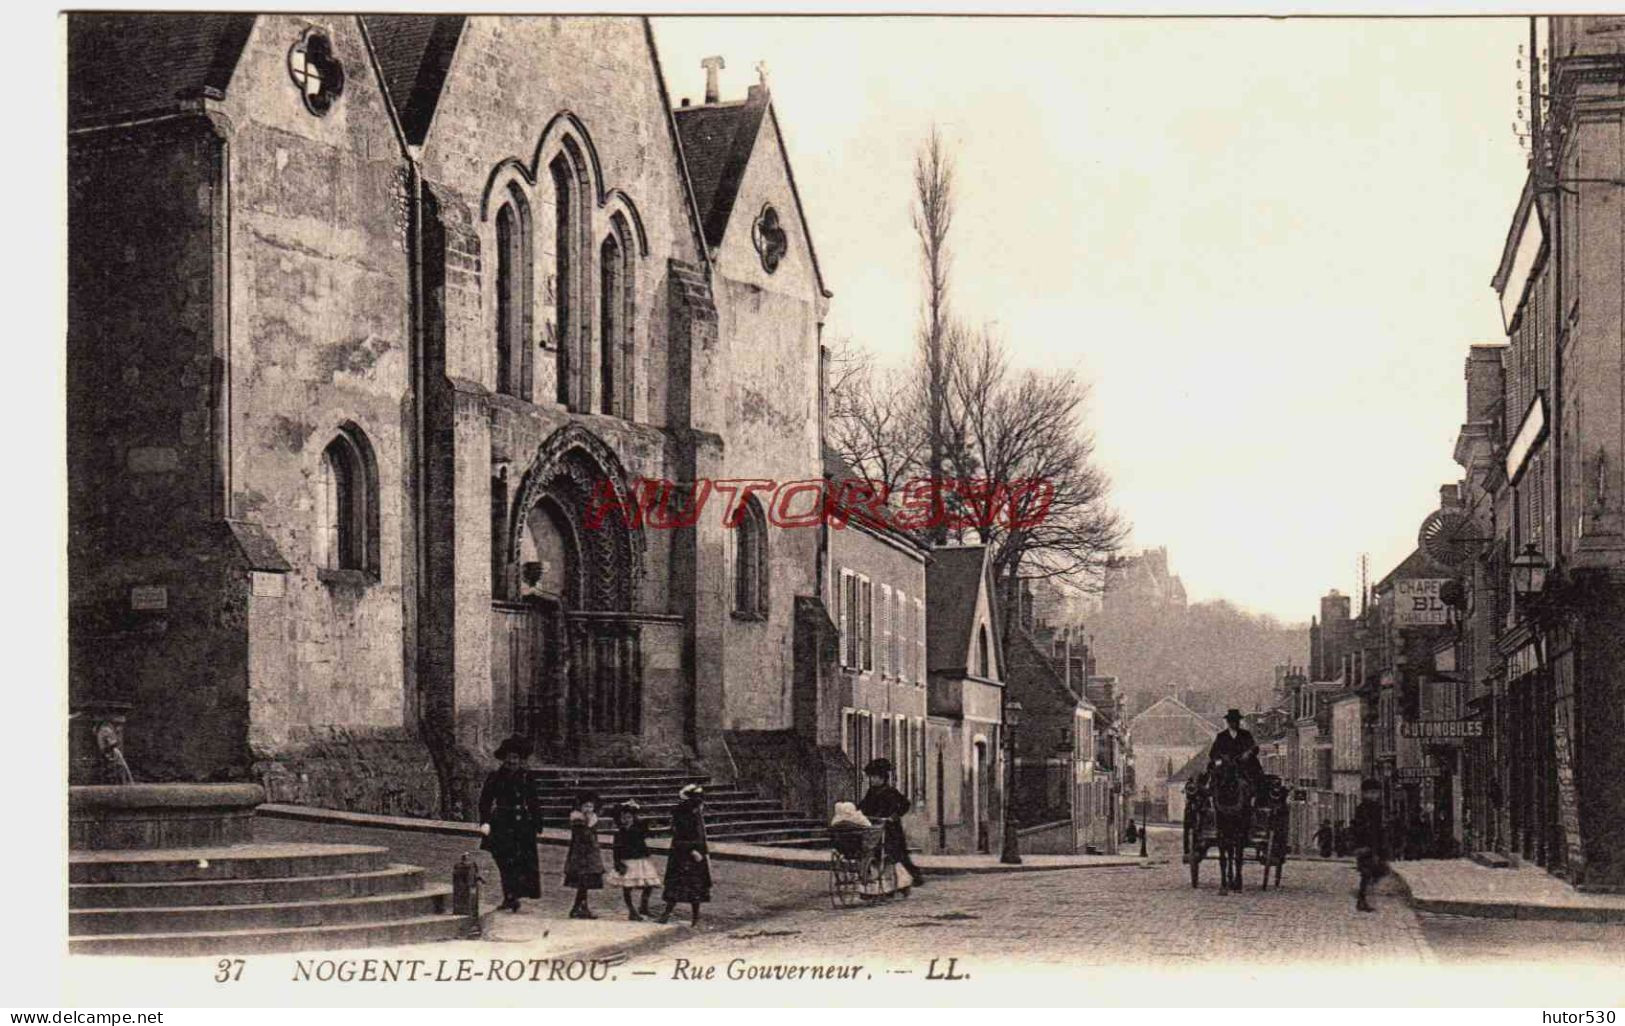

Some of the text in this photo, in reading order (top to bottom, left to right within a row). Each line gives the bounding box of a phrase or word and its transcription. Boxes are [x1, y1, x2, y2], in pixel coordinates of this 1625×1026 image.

[1400, 580, 1441, 594] CHAPE
[1412, 597, 1443, 611] BL
[1402, 722, 1483, 737] AUTOMOBILES
